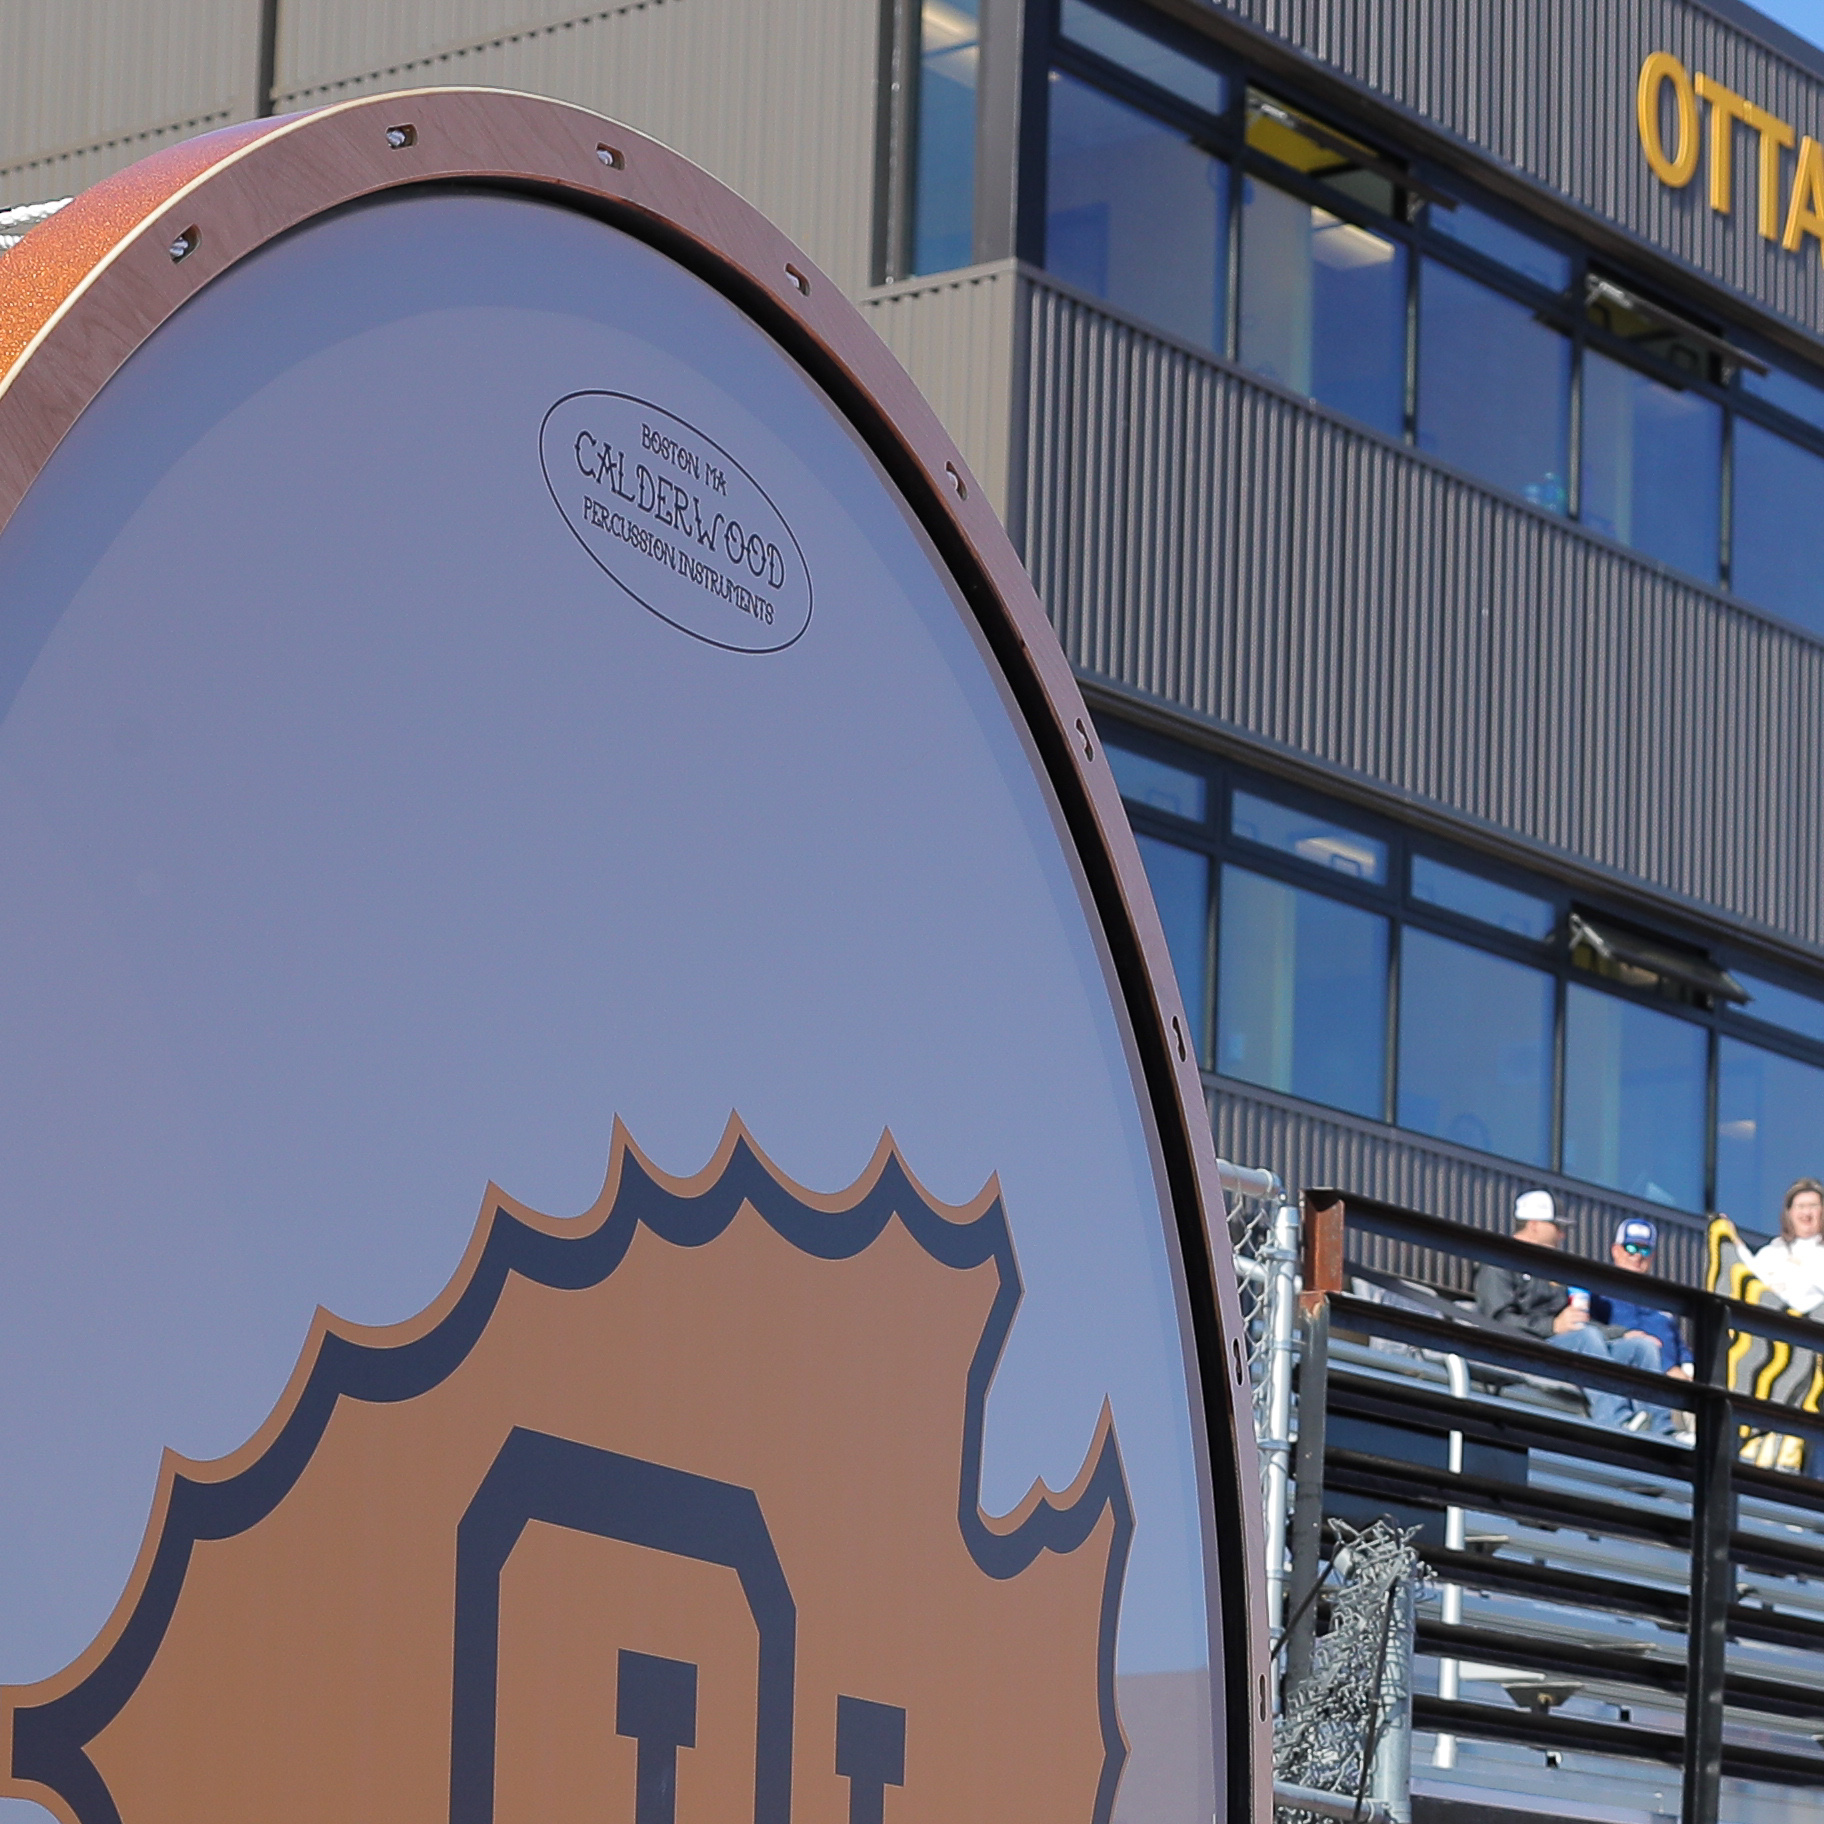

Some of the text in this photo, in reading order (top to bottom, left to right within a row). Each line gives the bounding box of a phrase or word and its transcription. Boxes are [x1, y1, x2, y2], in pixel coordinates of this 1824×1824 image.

[574, 431, 785, 590] CALDERWOOD
[705, 463, 728, 497] MA
[583, 495, 775, 626] PERCUSSION INSTRUMENTS
